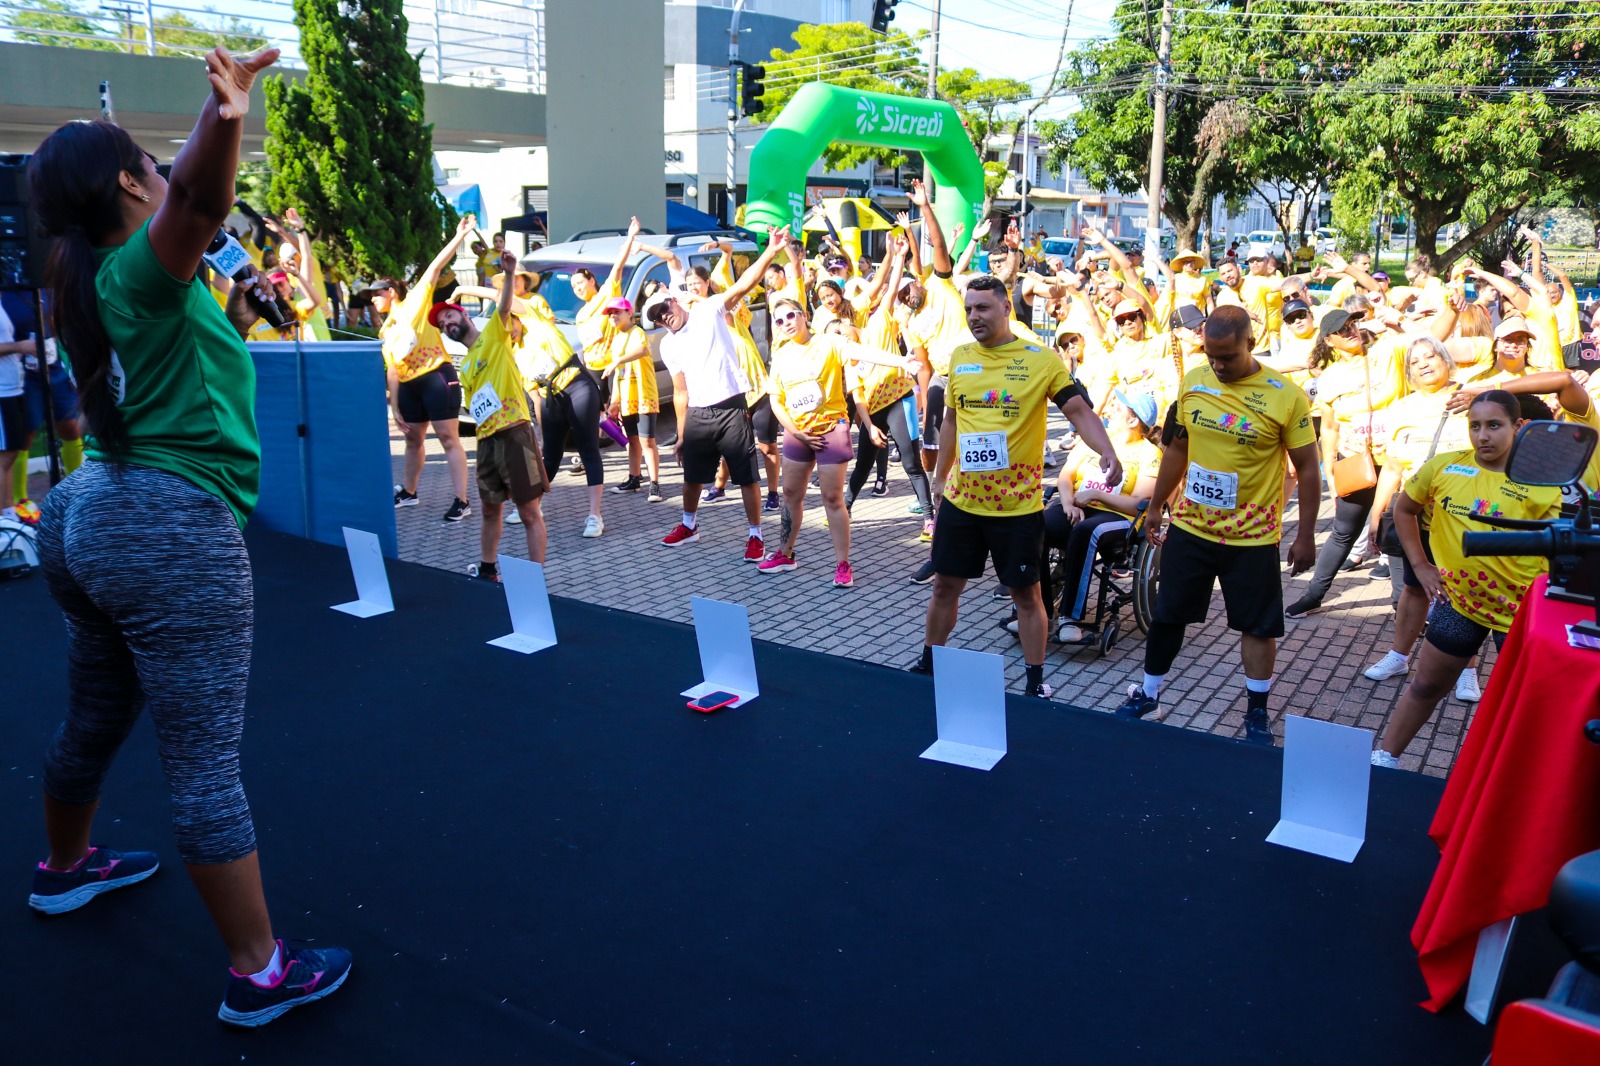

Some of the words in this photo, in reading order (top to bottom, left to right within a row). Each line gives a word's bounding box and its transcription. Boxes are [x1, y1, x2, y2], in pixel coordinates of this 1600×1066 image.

[880, 105, 943, 137] Sicredi
[223, 252, 245, 273] NEWS
[474, 398, 492, 418] 6174
[1244, 396, 1267, 407] MOTOR'S
[965, 449, 998, 463] 6369
[1193, 482, 1224, 500] 6152
[1449, 503, 1470, 511] Corrida
